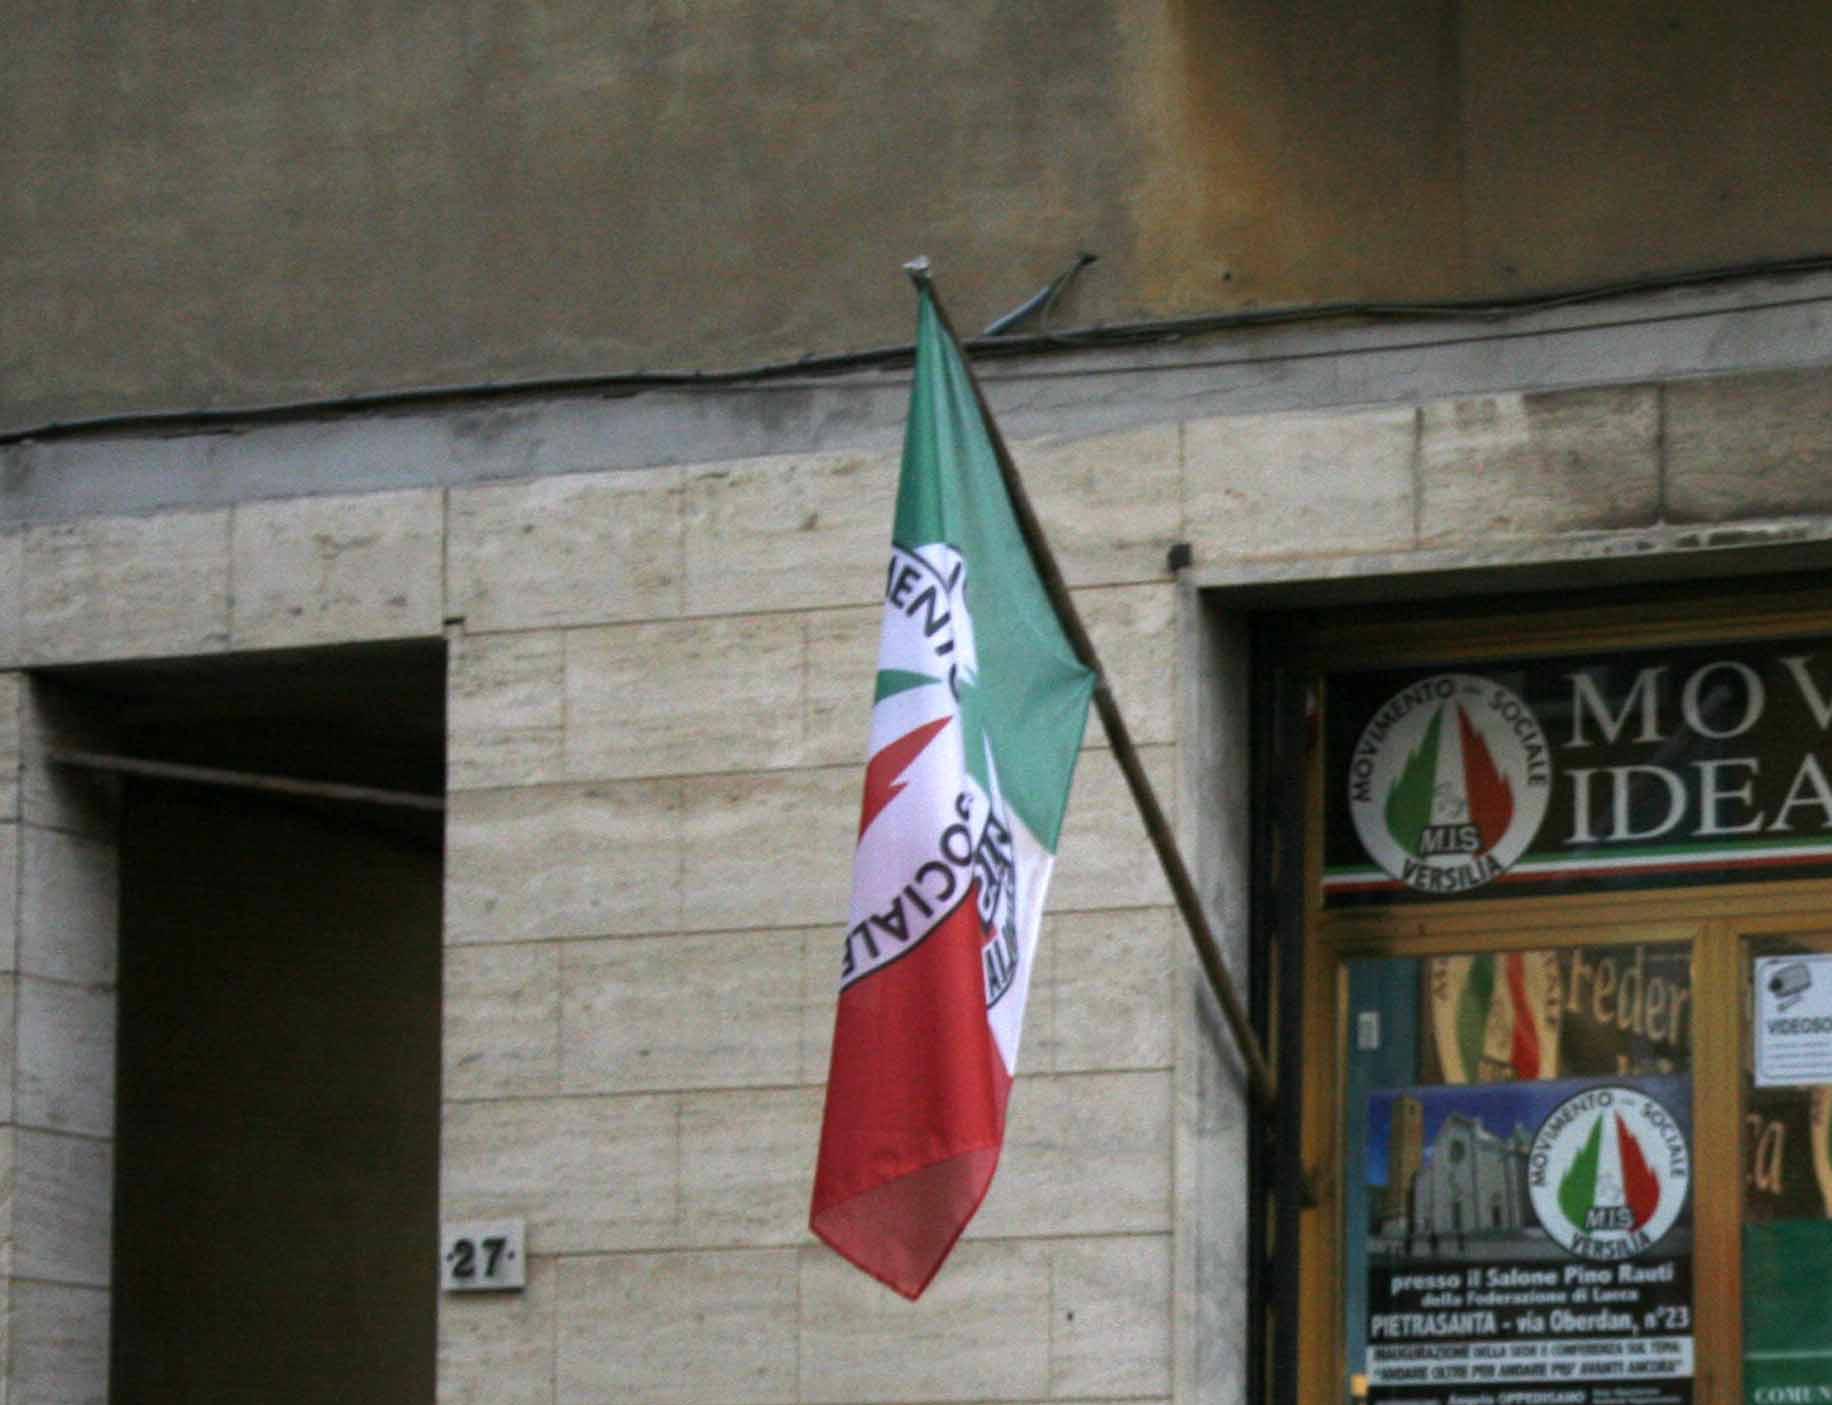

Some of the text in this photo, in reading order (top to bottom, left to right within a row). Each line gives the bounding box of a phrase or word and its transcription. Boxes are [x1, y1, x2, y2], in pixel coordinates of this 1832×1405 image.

[1353, 678, 1548, 802] MOVIMENTO SOCIALE
[1402, 855, 1502, 892] VERSILIA
[1640, 1102, 1685, 1179] SOCIALE
[451, 1237, 507, 1278] 27
[1486, 1266, 1557, 1287] Salone
[1564, 1264, 1612, 1285] Pino
[1617, 1261, 1674, 1283] Rauti
[1371, 1311, 1497, 1338] PIETRASANTA
[1516, 1311, 1545, 1333] via
